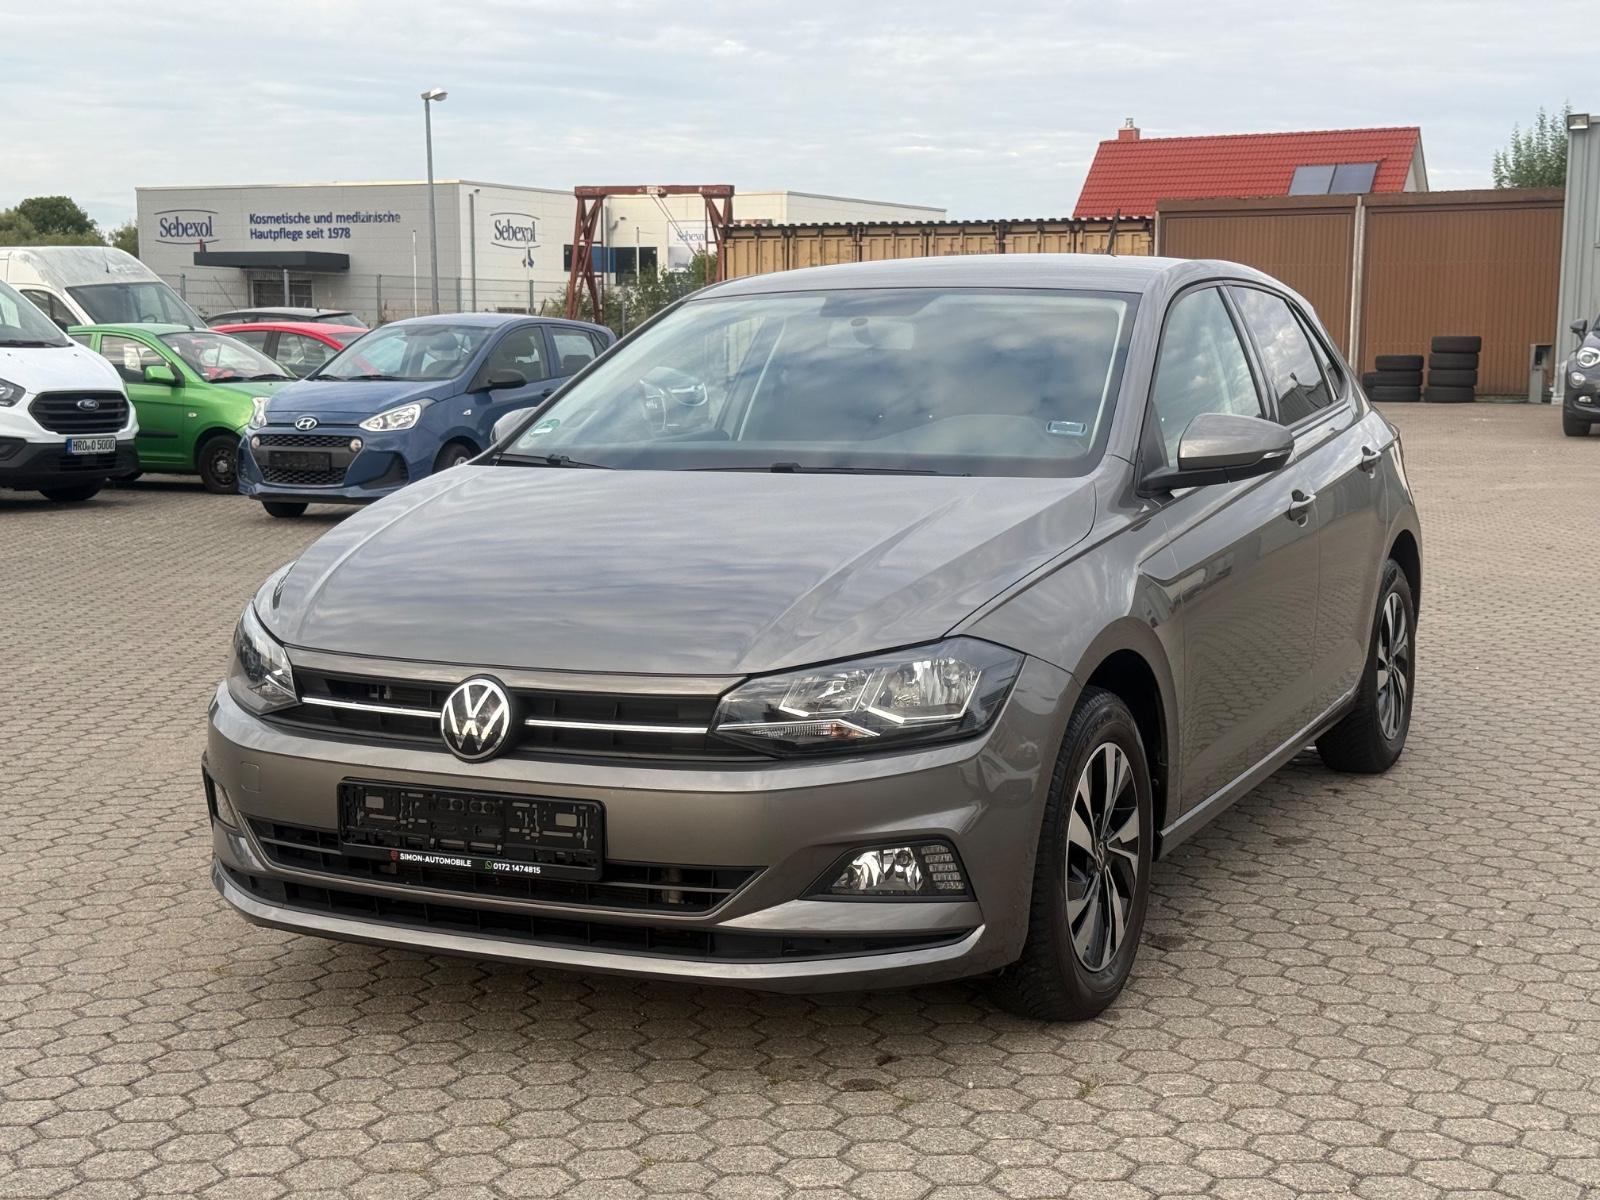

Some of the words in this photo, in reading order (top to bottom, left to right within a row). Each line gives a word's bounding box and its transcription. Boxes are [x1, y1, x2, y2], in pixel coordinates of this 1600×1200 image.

[249, 213, 311, 224] Kosmetische
[313, 212, 333, 223] und
[335, 210, 401, 223] medizinische
[159, 216, 213, 238] Sebexol
[250, 228, 303, 241] Hautpflege
[306, 227, 325, 239] seit
[327, 227, 351, 239] 1978
[400, 853, 472, 867] SIMON-AUTOMOBILE
[493, 862, 510, 872] 0172
[511, 864, 541, 874] 1474815
